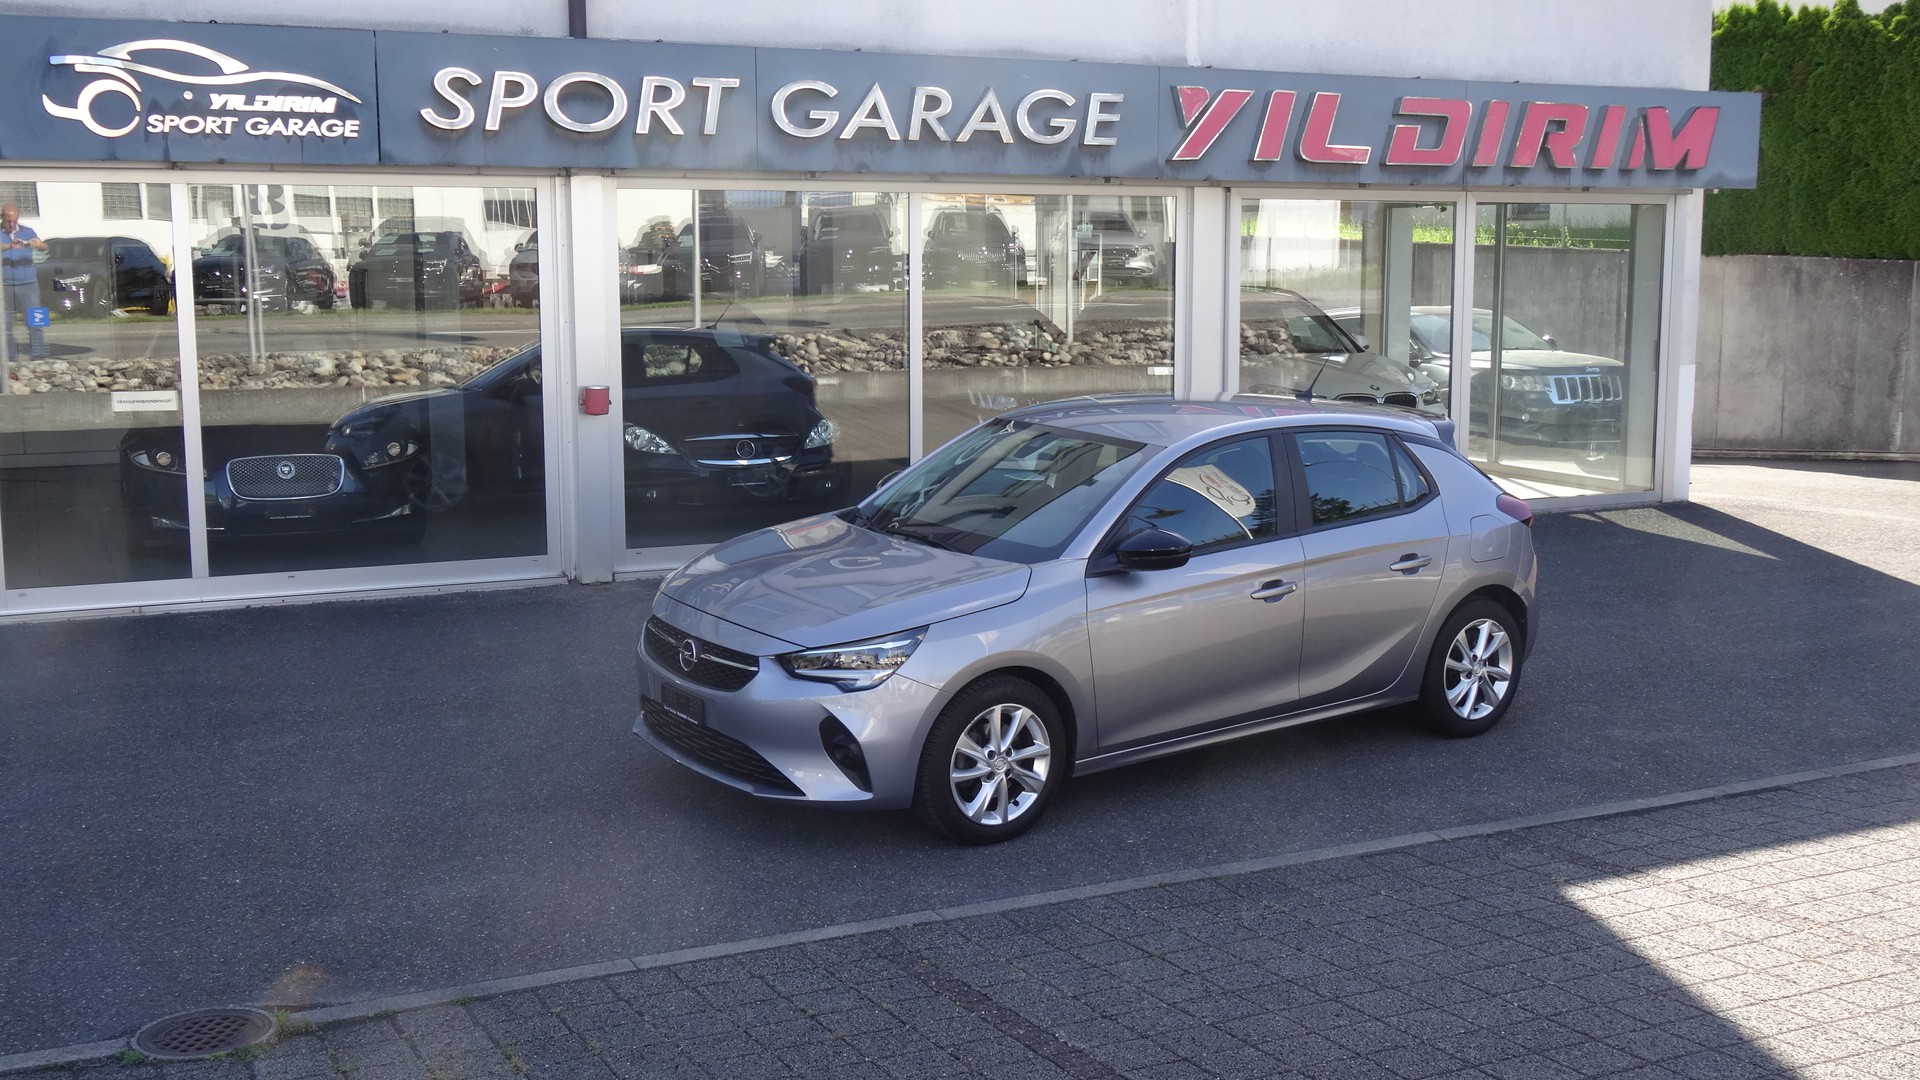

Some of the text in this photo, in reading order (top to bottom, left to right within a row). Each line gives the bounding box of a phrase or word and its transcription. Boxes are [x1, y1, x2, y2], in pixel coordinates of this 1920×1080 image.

[209, 93, 337, 113] YILDIRIM
[146, 114, 360, 138] SPORT GARAGE
[420, 66, 1720, 171] SPORT GARAGE YILDIRIM
